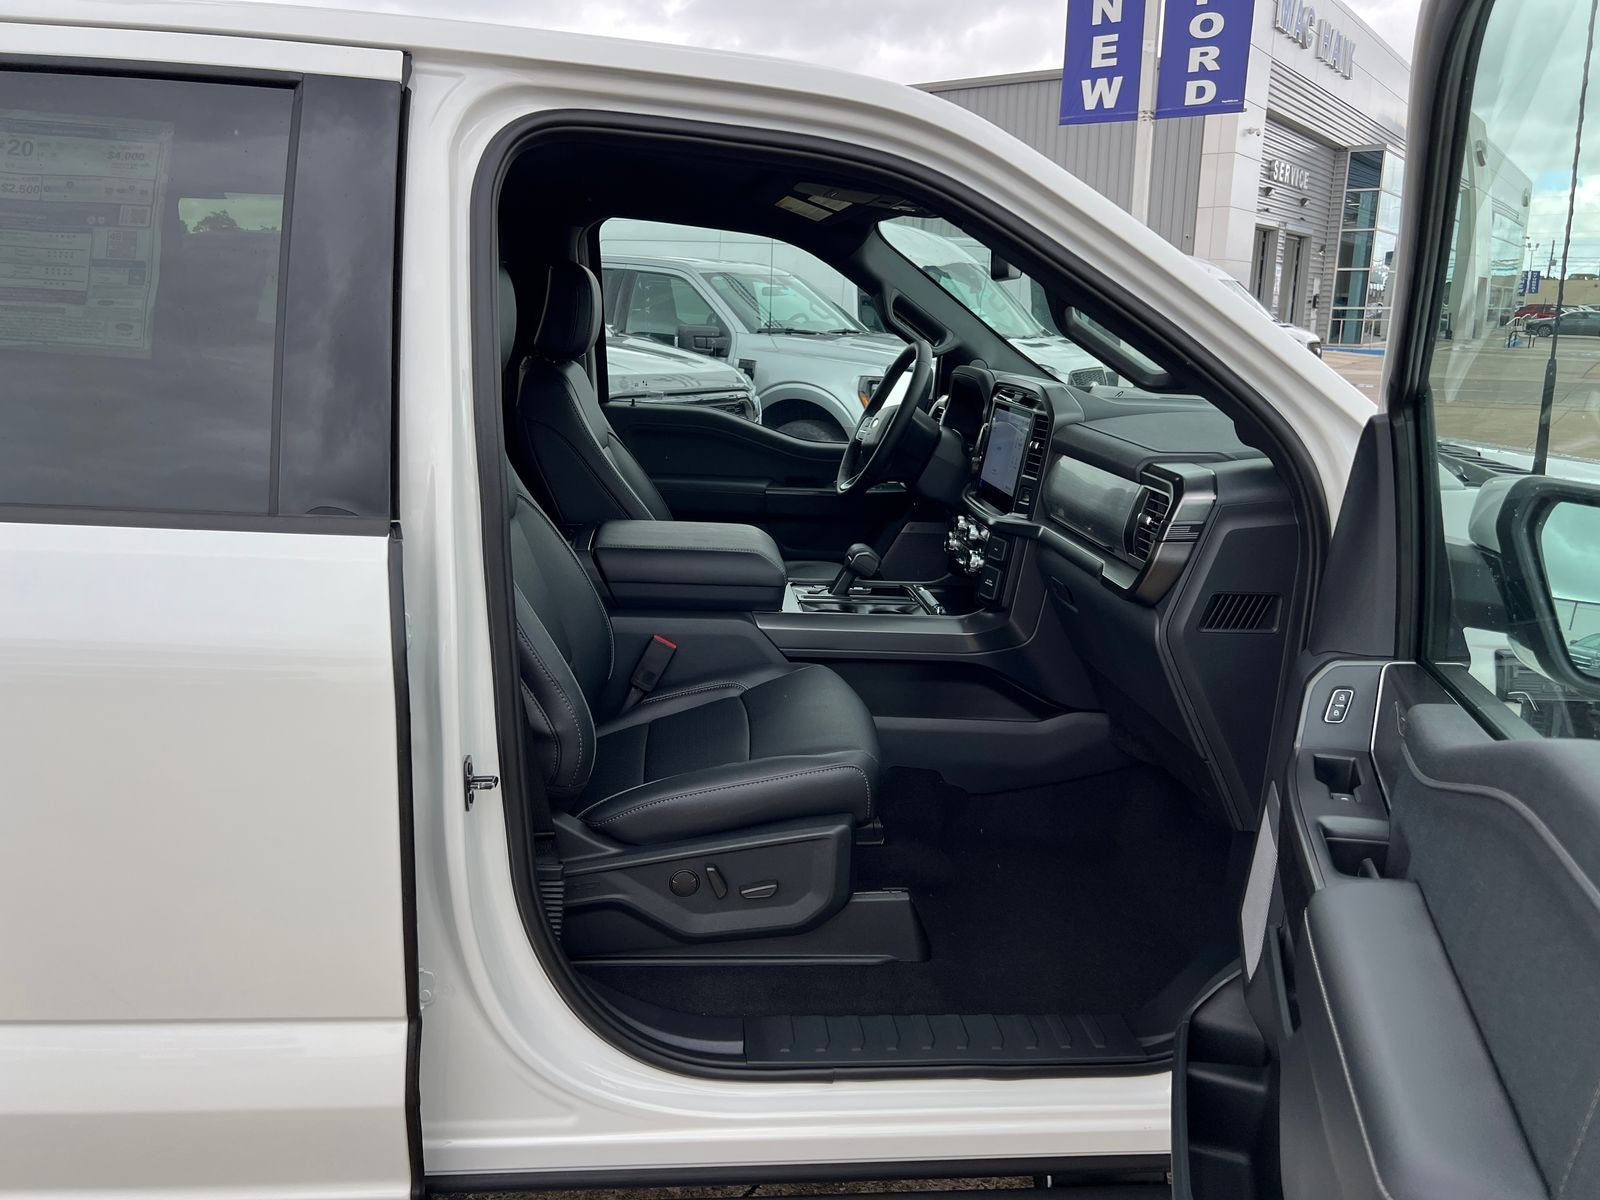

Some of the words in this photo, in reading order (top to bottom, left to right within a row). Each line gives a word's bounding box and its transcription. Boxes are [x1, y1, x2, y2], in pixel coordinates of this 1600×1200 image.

[1081, 0, 1124, 111] NEW
[1184, 0, 1225, 106] ORD
[8, 139, 34, 157] 20
[1272, 160, 1310, 190] SERVICE
